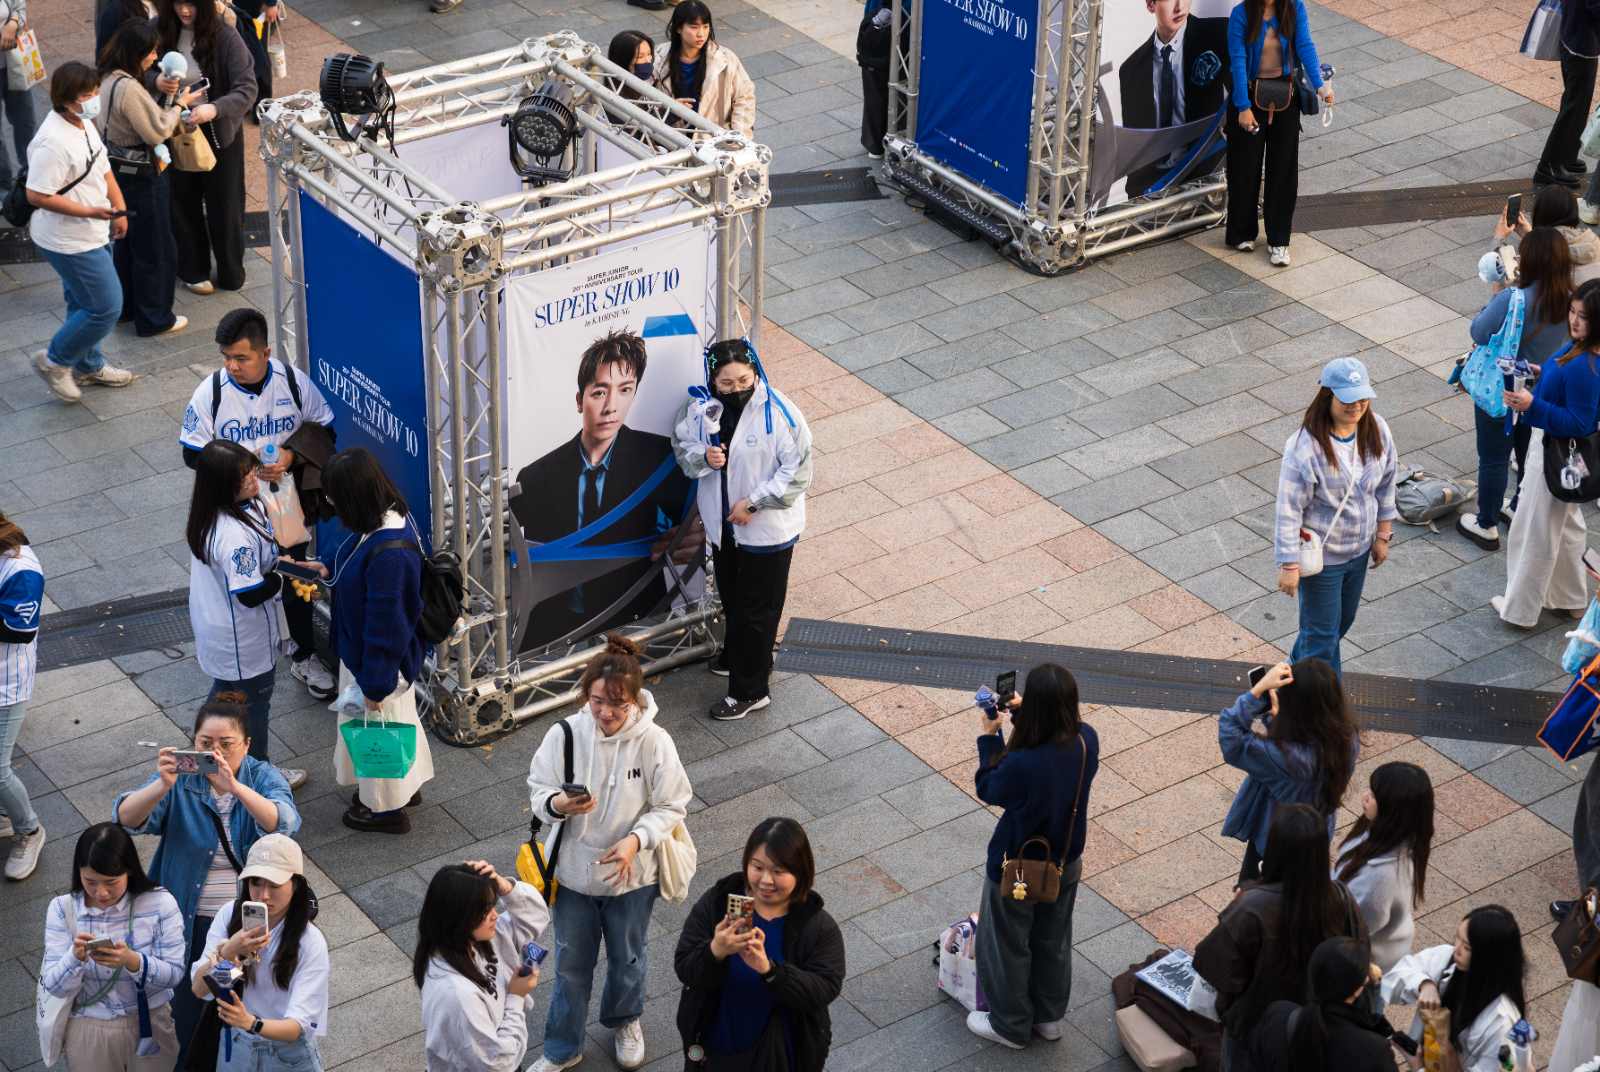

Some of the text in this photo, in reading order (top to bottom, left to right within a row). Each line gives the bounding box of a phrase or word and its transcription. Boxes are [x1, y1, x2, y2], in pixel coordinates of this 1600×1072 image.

[975, 0, 1014, 32] SHOW
[1014, 16, 1028, 40] 10
[535, 267, 680, 329] SUPER SHOW 10
[318, 358, 362, 414] SUPER
[363, 394, 404, 443] SHOW
[405, 427, 419, 457] 10
